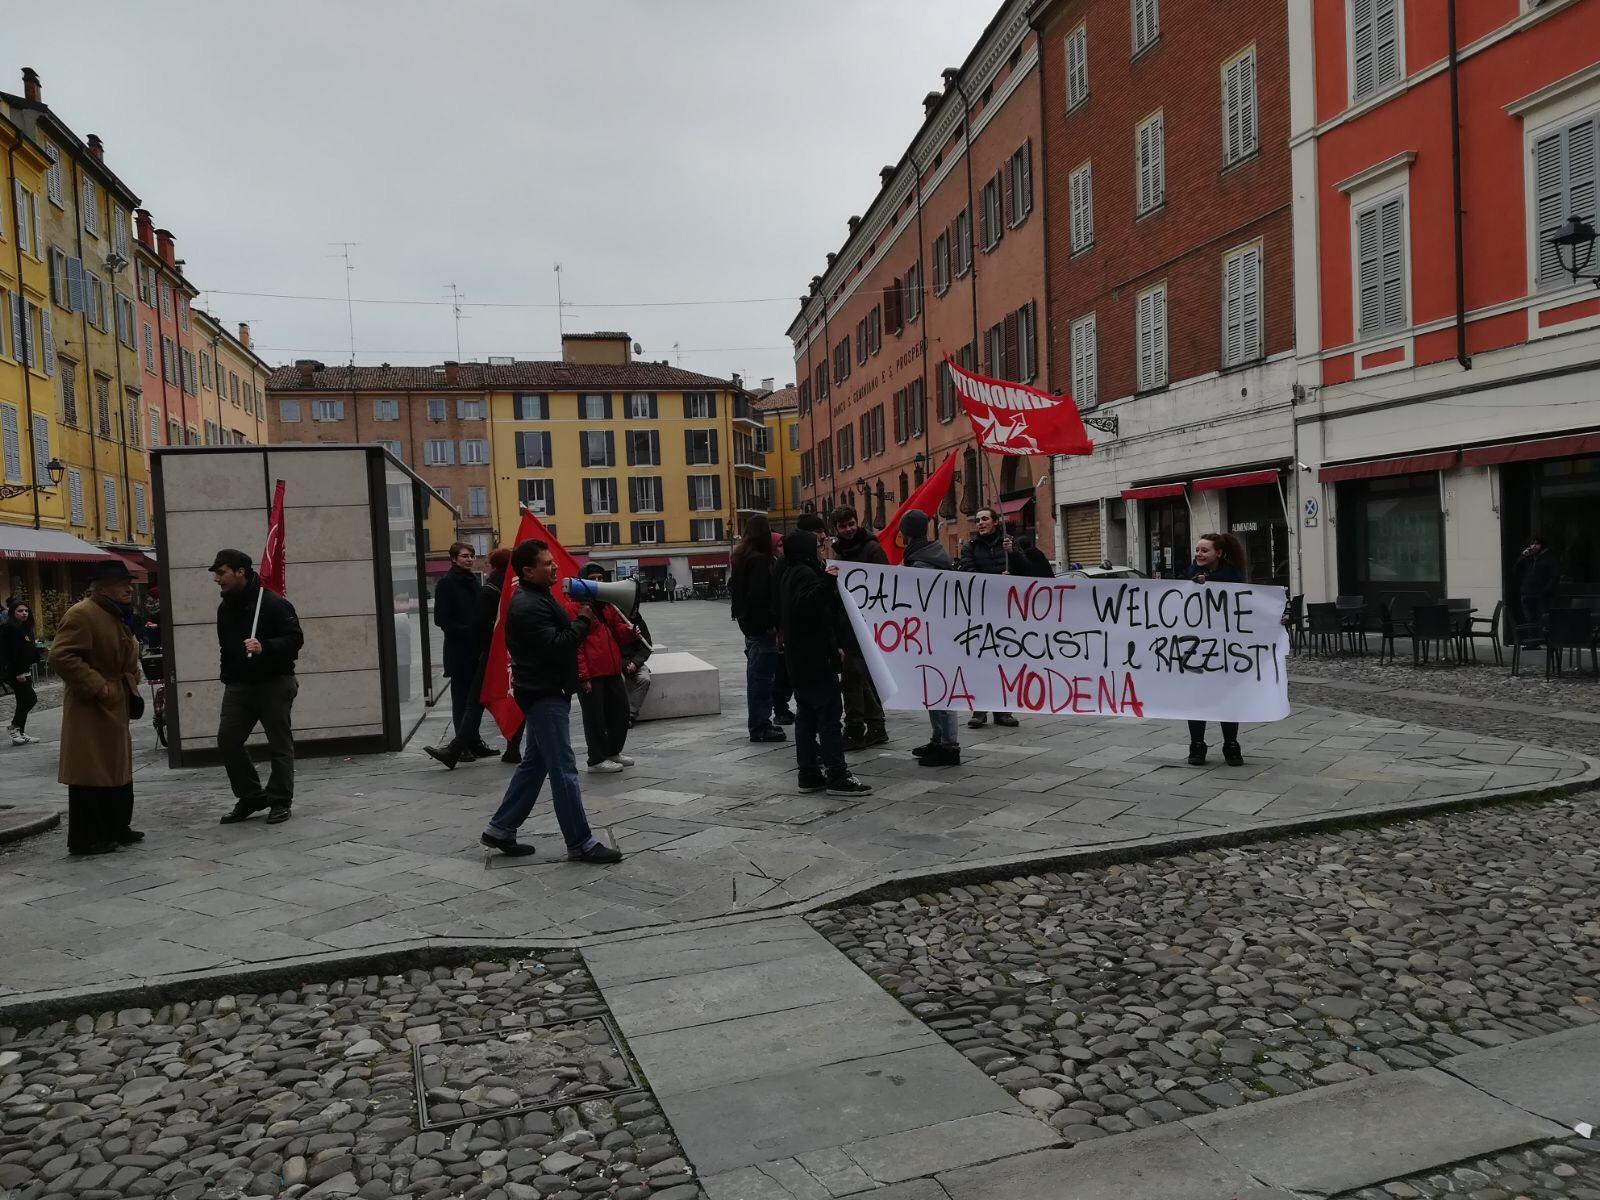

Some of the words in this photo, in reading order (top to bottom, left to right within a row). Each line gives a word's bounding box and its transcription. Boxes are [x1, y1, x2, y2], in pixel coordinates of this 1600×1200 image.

[844, 568, 986, 619] SALVINI
[1007, 580, 1077, 623] NOT
[1092, 583, 1254, 634] WELCOME
[873, 616, 933, 656] ORI
[953, 619, 1109, 669] FASCISTI
[1148, 634, 1280, 684] RAZZISTI
[914, 664, 977, 712] DA
[997, 663, 1145, 718] MODENA
